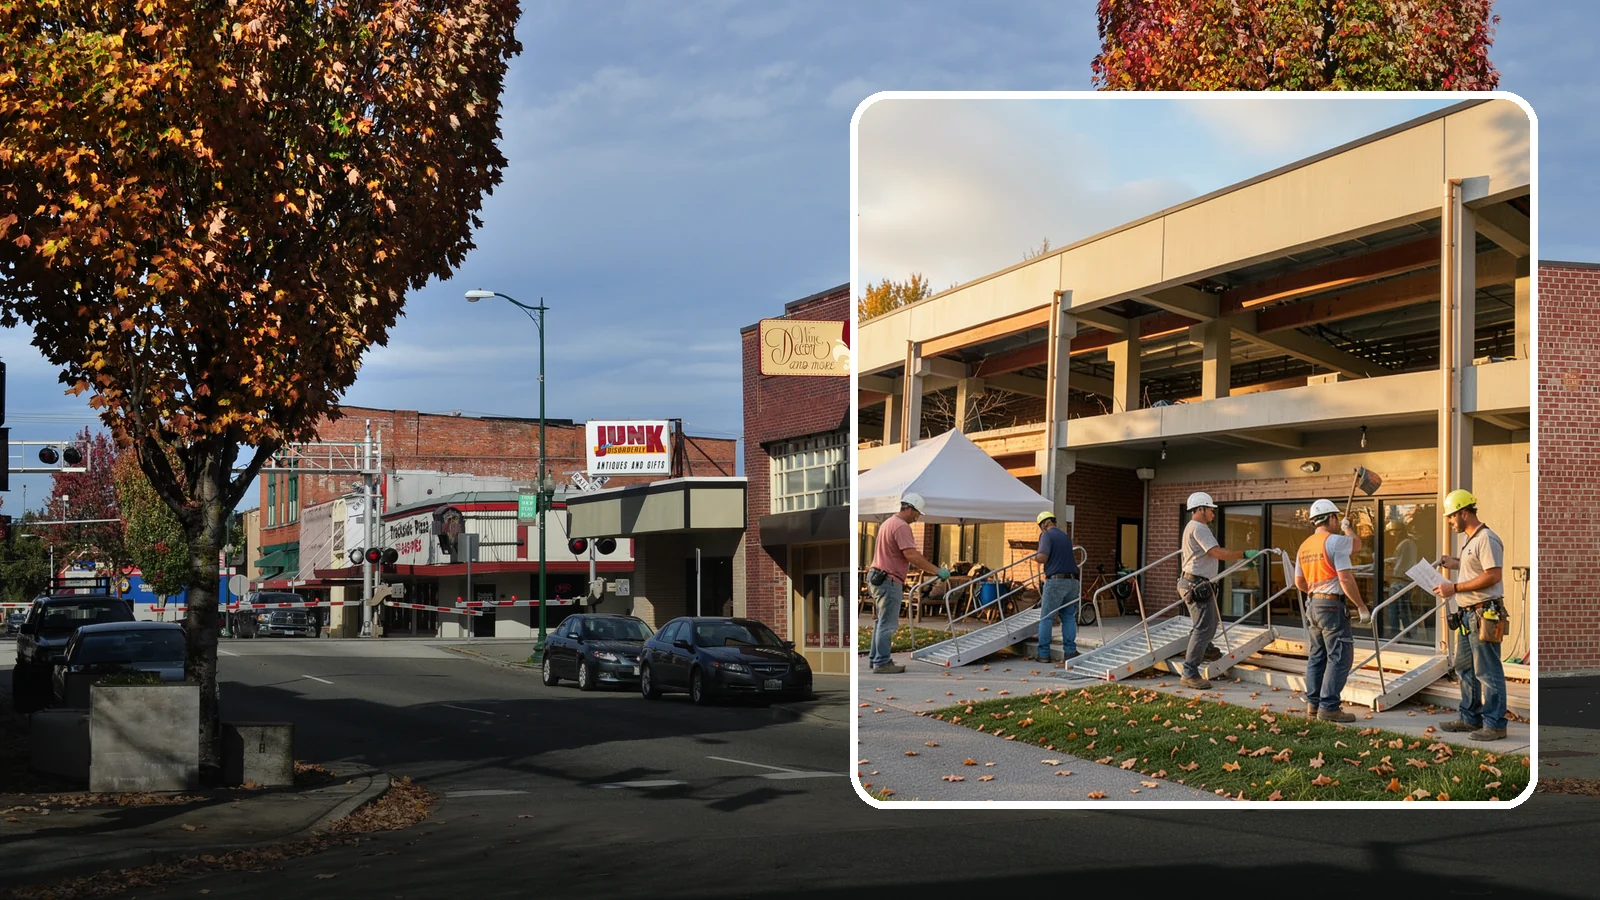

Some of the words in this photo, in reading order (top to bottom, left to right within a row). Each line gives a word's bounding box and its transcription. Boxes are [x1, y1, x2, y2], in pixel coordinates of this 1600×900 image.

[596, 425, 665, 457] JUNK
[607, 446, 646, 454] DISORDERLY
[597, 461, 628, 470] ANTIQUES
[631, 461, 644, 469] AND
[647, 460, 665, 469] GIFTS
[415, 519, 429, 534] Pizza
